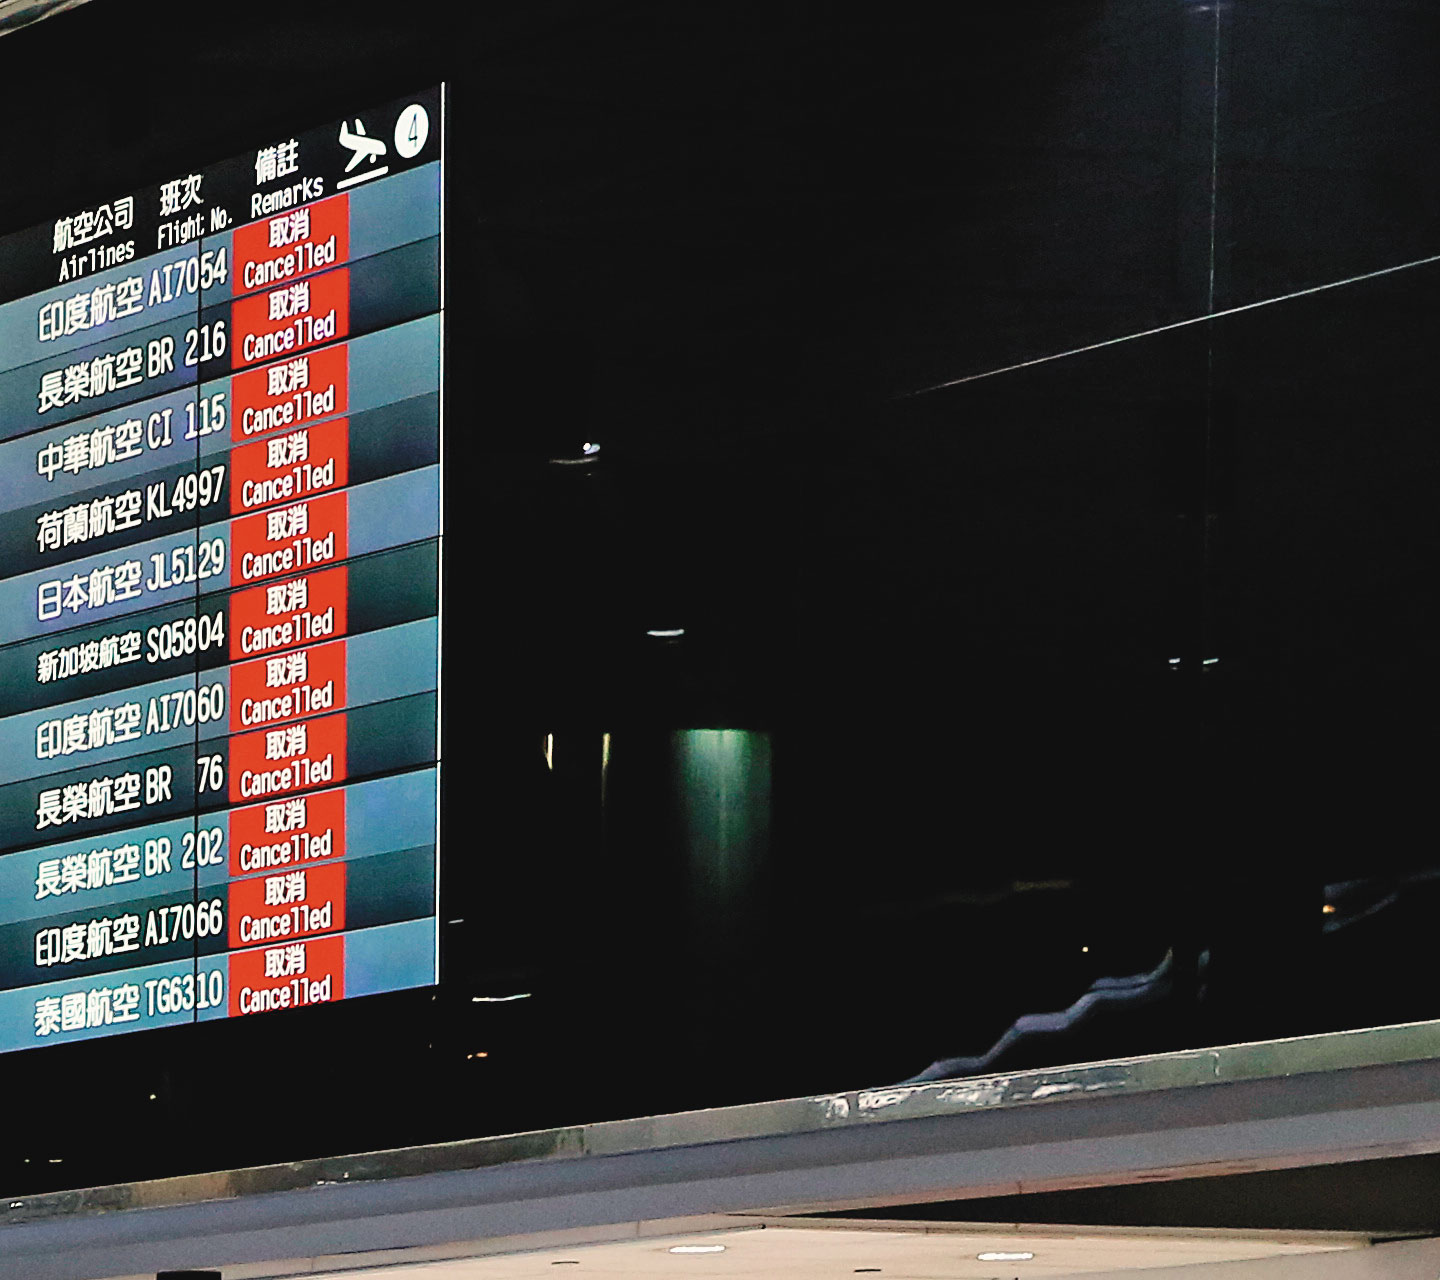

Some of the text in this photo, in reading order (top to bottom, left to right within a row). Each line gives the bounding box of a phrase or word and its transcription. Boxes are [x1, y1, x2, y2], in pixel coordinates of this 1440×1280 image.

[254, 139, 299, 185] 備註
[52, 174, 203, 254] 航空公司 班次
[250, 176, 323, 217] Remarks
[59, 206, 232, 282] Airlines Flight No.
[269, 209, 310, 249] 取消
[244, 236, 335, 289] Cancelled
[38, 277, 144, 343] 印度航空
[147, 247, 227, 307] AI7054
[269, 282, 310, 321] 取消
[243, 310, 334, 362] Cancelled
[37, 349, 144, 414] 長榮航空
[147, 337, 173, 378] BR
[185, 321, 226, 367] 216
[267, 357, 309, 397] 取消
[242, 386, 334, 436] Cancelled
[37, 419, 142, 481] 中華航空
[147, 409, 172, 449] CI
[184, 393, 226, 441] 115
[265, 799, 306, 834] 取消
[35, 844, 140, 900] 長榮航空
[145, 837, 171, 877] BR
[182, 828, 223, 870] 202
[240, 829, 331, 871] Cancelled
[265, 944, 305, 978] 取消
[35, 984, 140, 1036] 泰國航空
[145, 970, 223, 1016] TG6310
[240, 974, 331, 1015] Cancelled
